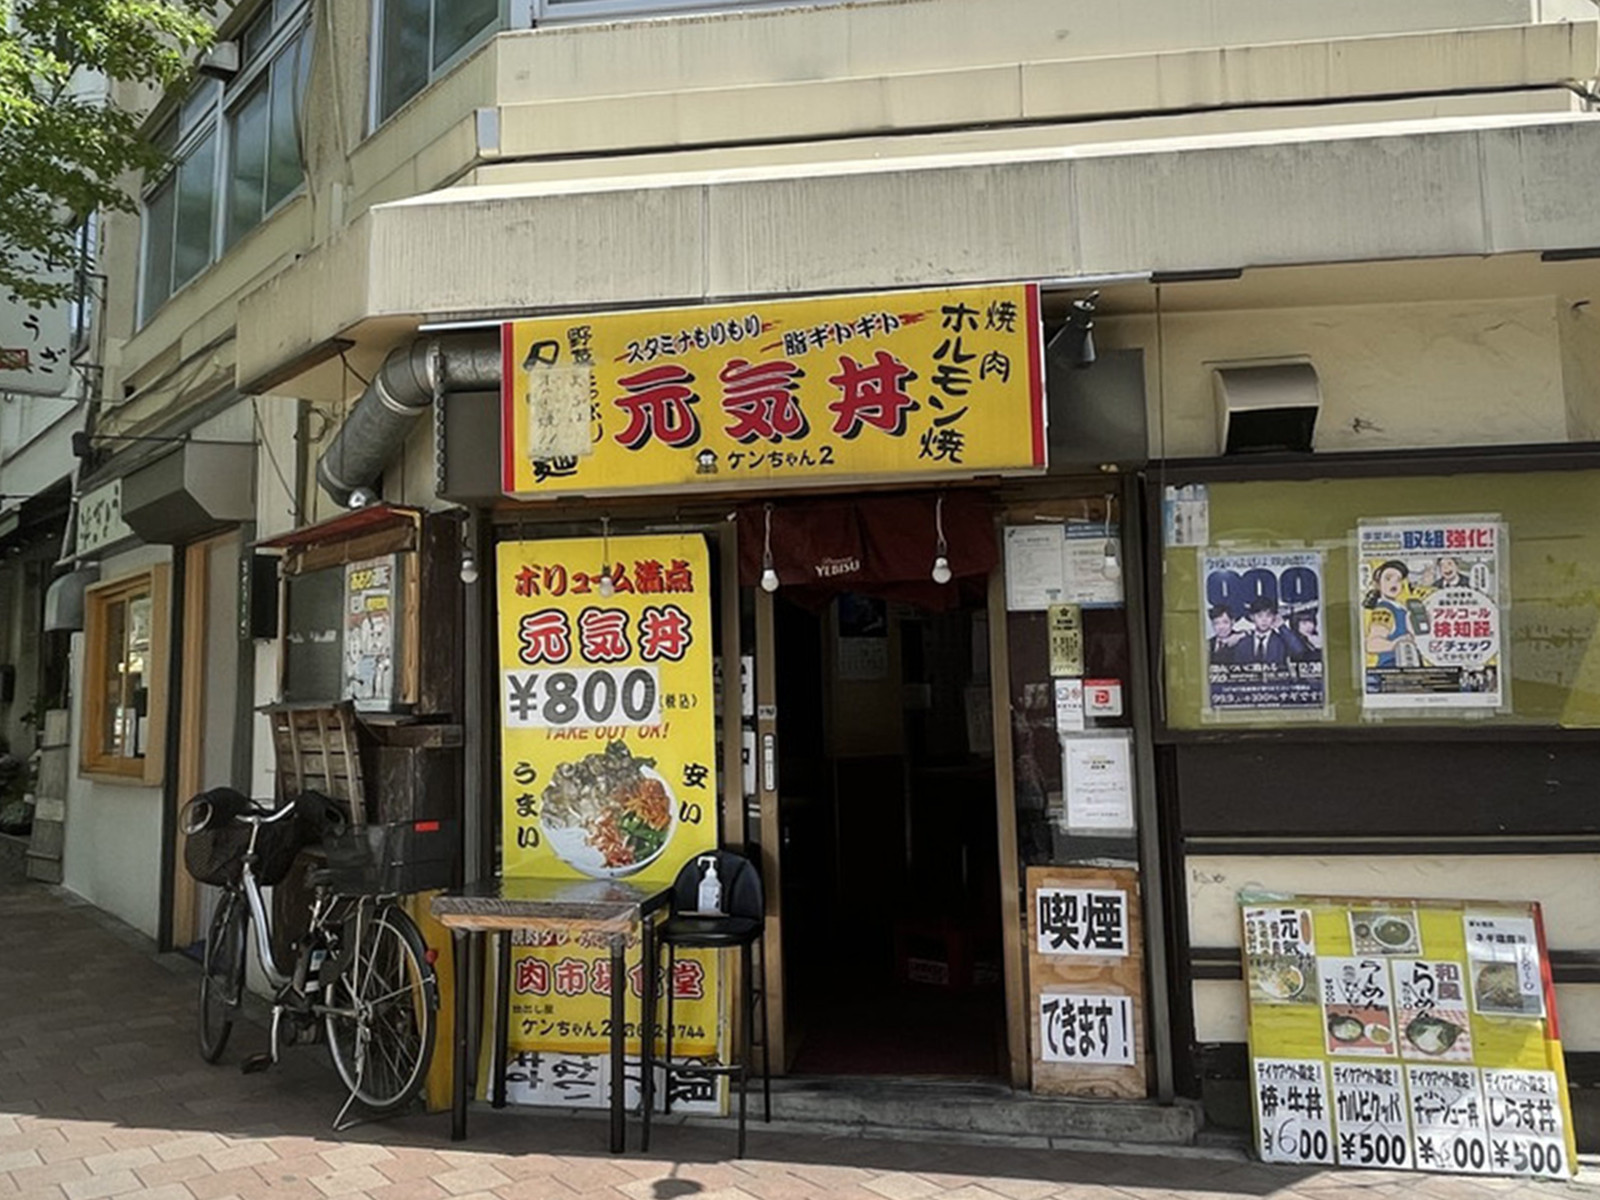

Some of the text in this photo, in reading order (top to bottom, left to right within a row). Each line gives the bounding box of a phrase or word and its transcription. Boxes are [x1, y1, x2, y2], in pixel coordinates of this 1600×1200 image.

[626, 314, 764, 364] スタミナもりもり
[782, 312, 901, 356] 脂ギトギト
[980, 300, 1017, 383] 焼肉
[613, 350, 917, 450] 元気丼
[919, 302, 979, 464] ホルモン焼
[727, 446, 835, 470] ケンちゃん2
[515, 559, 694, 598] ボリューム満点
[519, 604, 693, 664] 元気丼
[1433, 607, 1491, 620] アルコール
[1443, 640, 1492, 652] チェック
[507, 668, 658, 725] ¥800
[595, 724, 628, 740] OUT
[513, 761, 541, 850] うまい
[678, 762, 710, 825] 安い
[1040, 892, 1124, 950] 喫煙
[521, 1018, 612, 1038] ケンちゃん2
[1042, 998, 1129, 1058] できます!
[1489, 1097, 1557, 1132] しらす丼
[1340, 1132, 1407, 1166] ¥500
